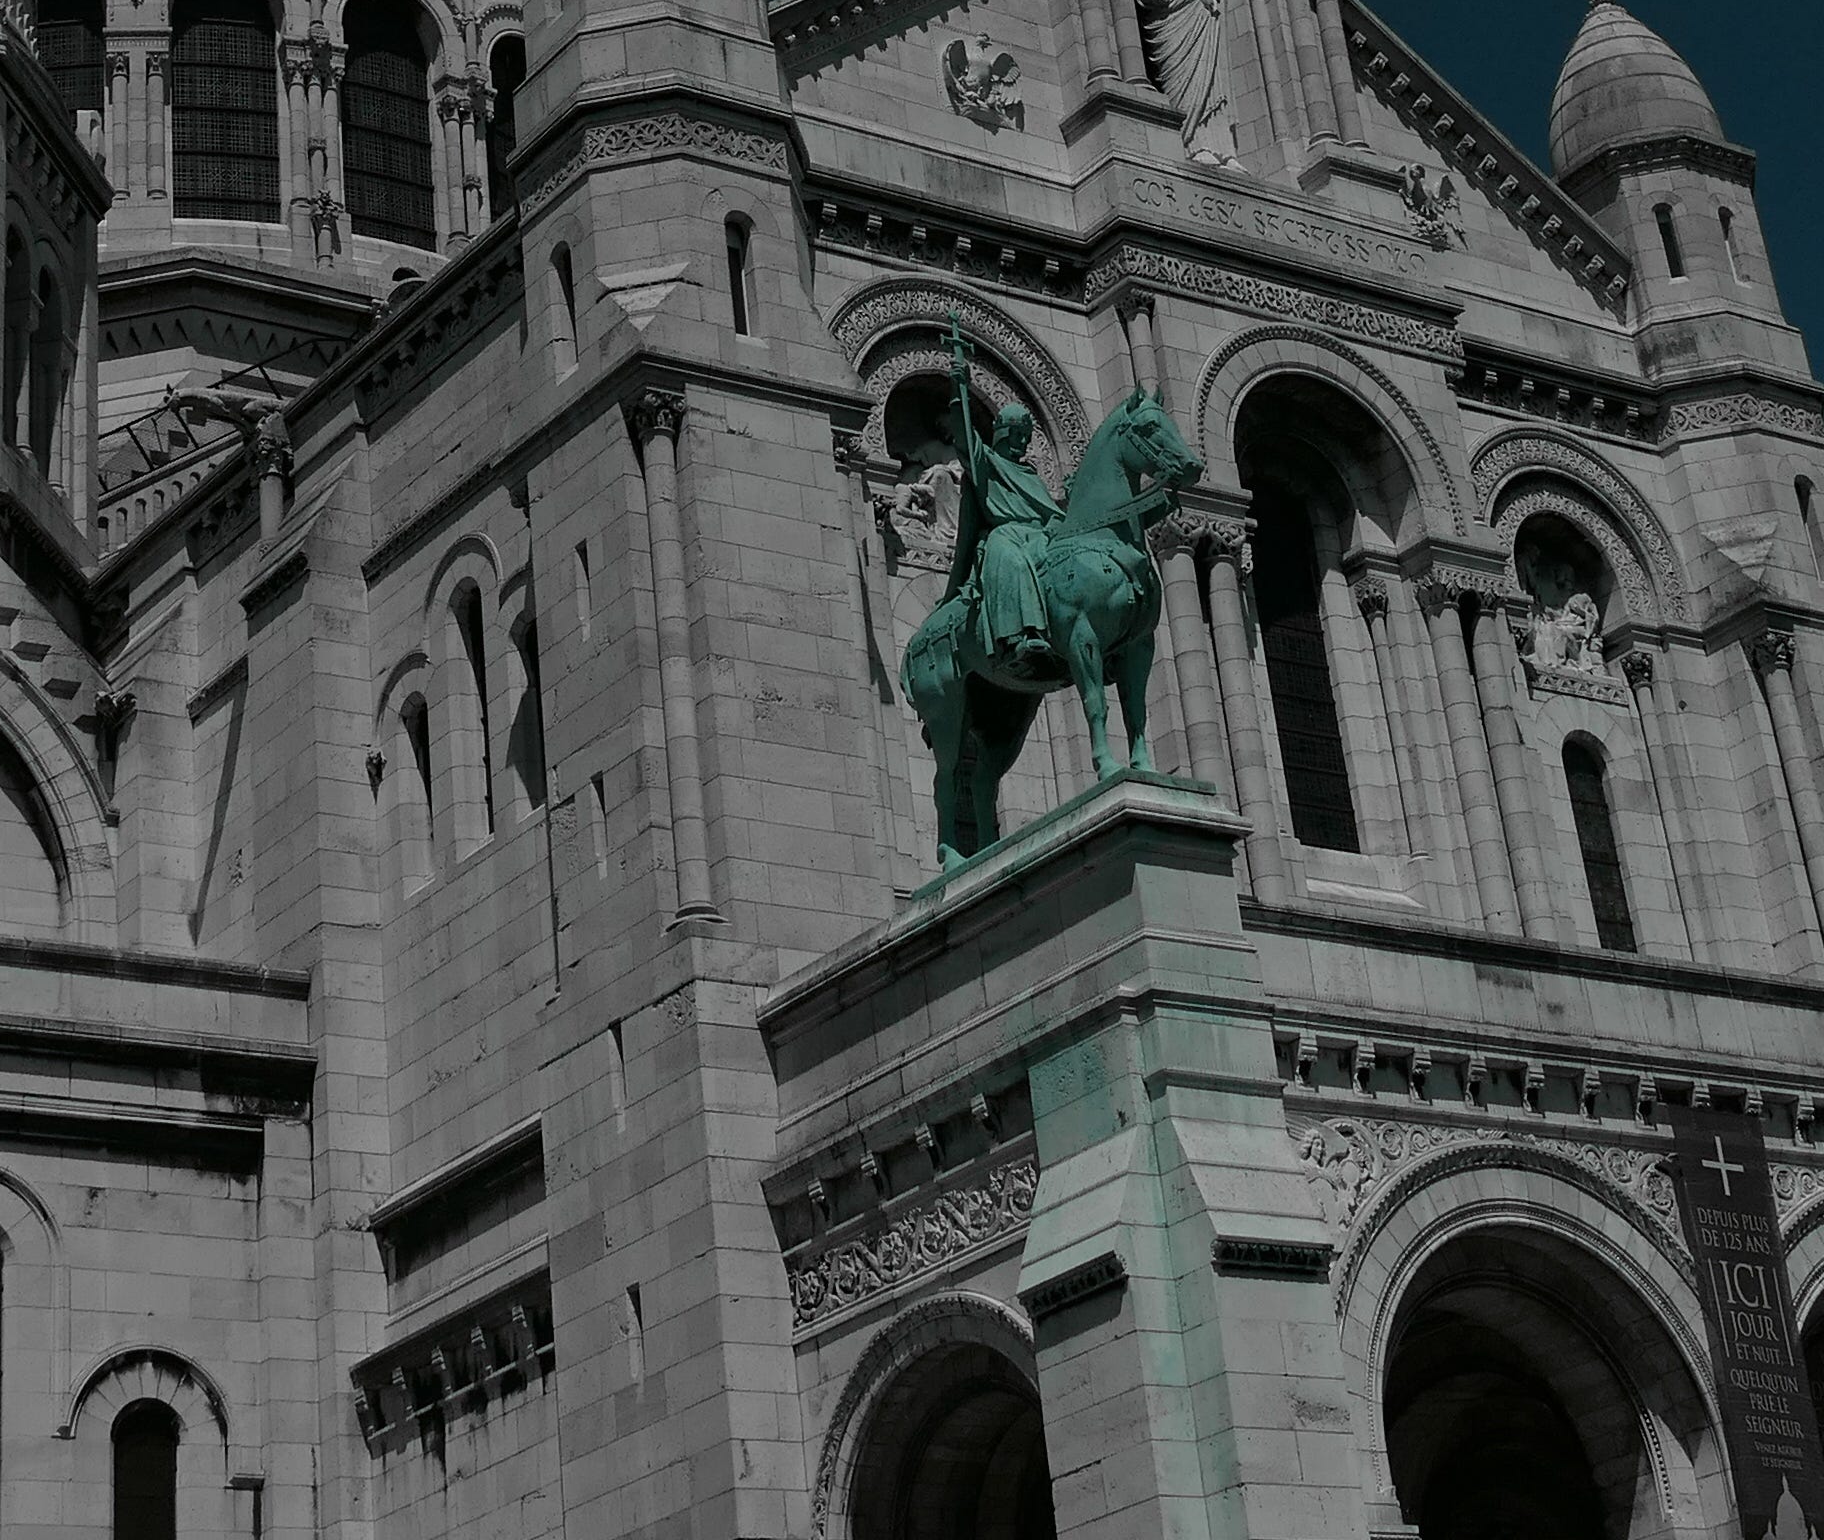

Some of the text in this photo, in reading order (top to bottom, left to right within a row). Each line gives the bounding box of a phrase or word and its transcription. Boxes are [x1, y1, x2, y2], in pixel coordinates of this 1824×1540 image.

[1697, 1207, 1769, 1233] DEPUIS PLUS
[1701, 1227, 1773, 1255] DE 125 ANS.
[1718, 1259, 1772, 1309] ICI
[1730, 1310, 1779, 1341] JOUR
[1735, 1343, 1784, 1365] ET NUIT.
[1749, 1393, 1791, 1414] PRIE LE
[1745, 1415, 1805, 1439] SEIGNEUR
